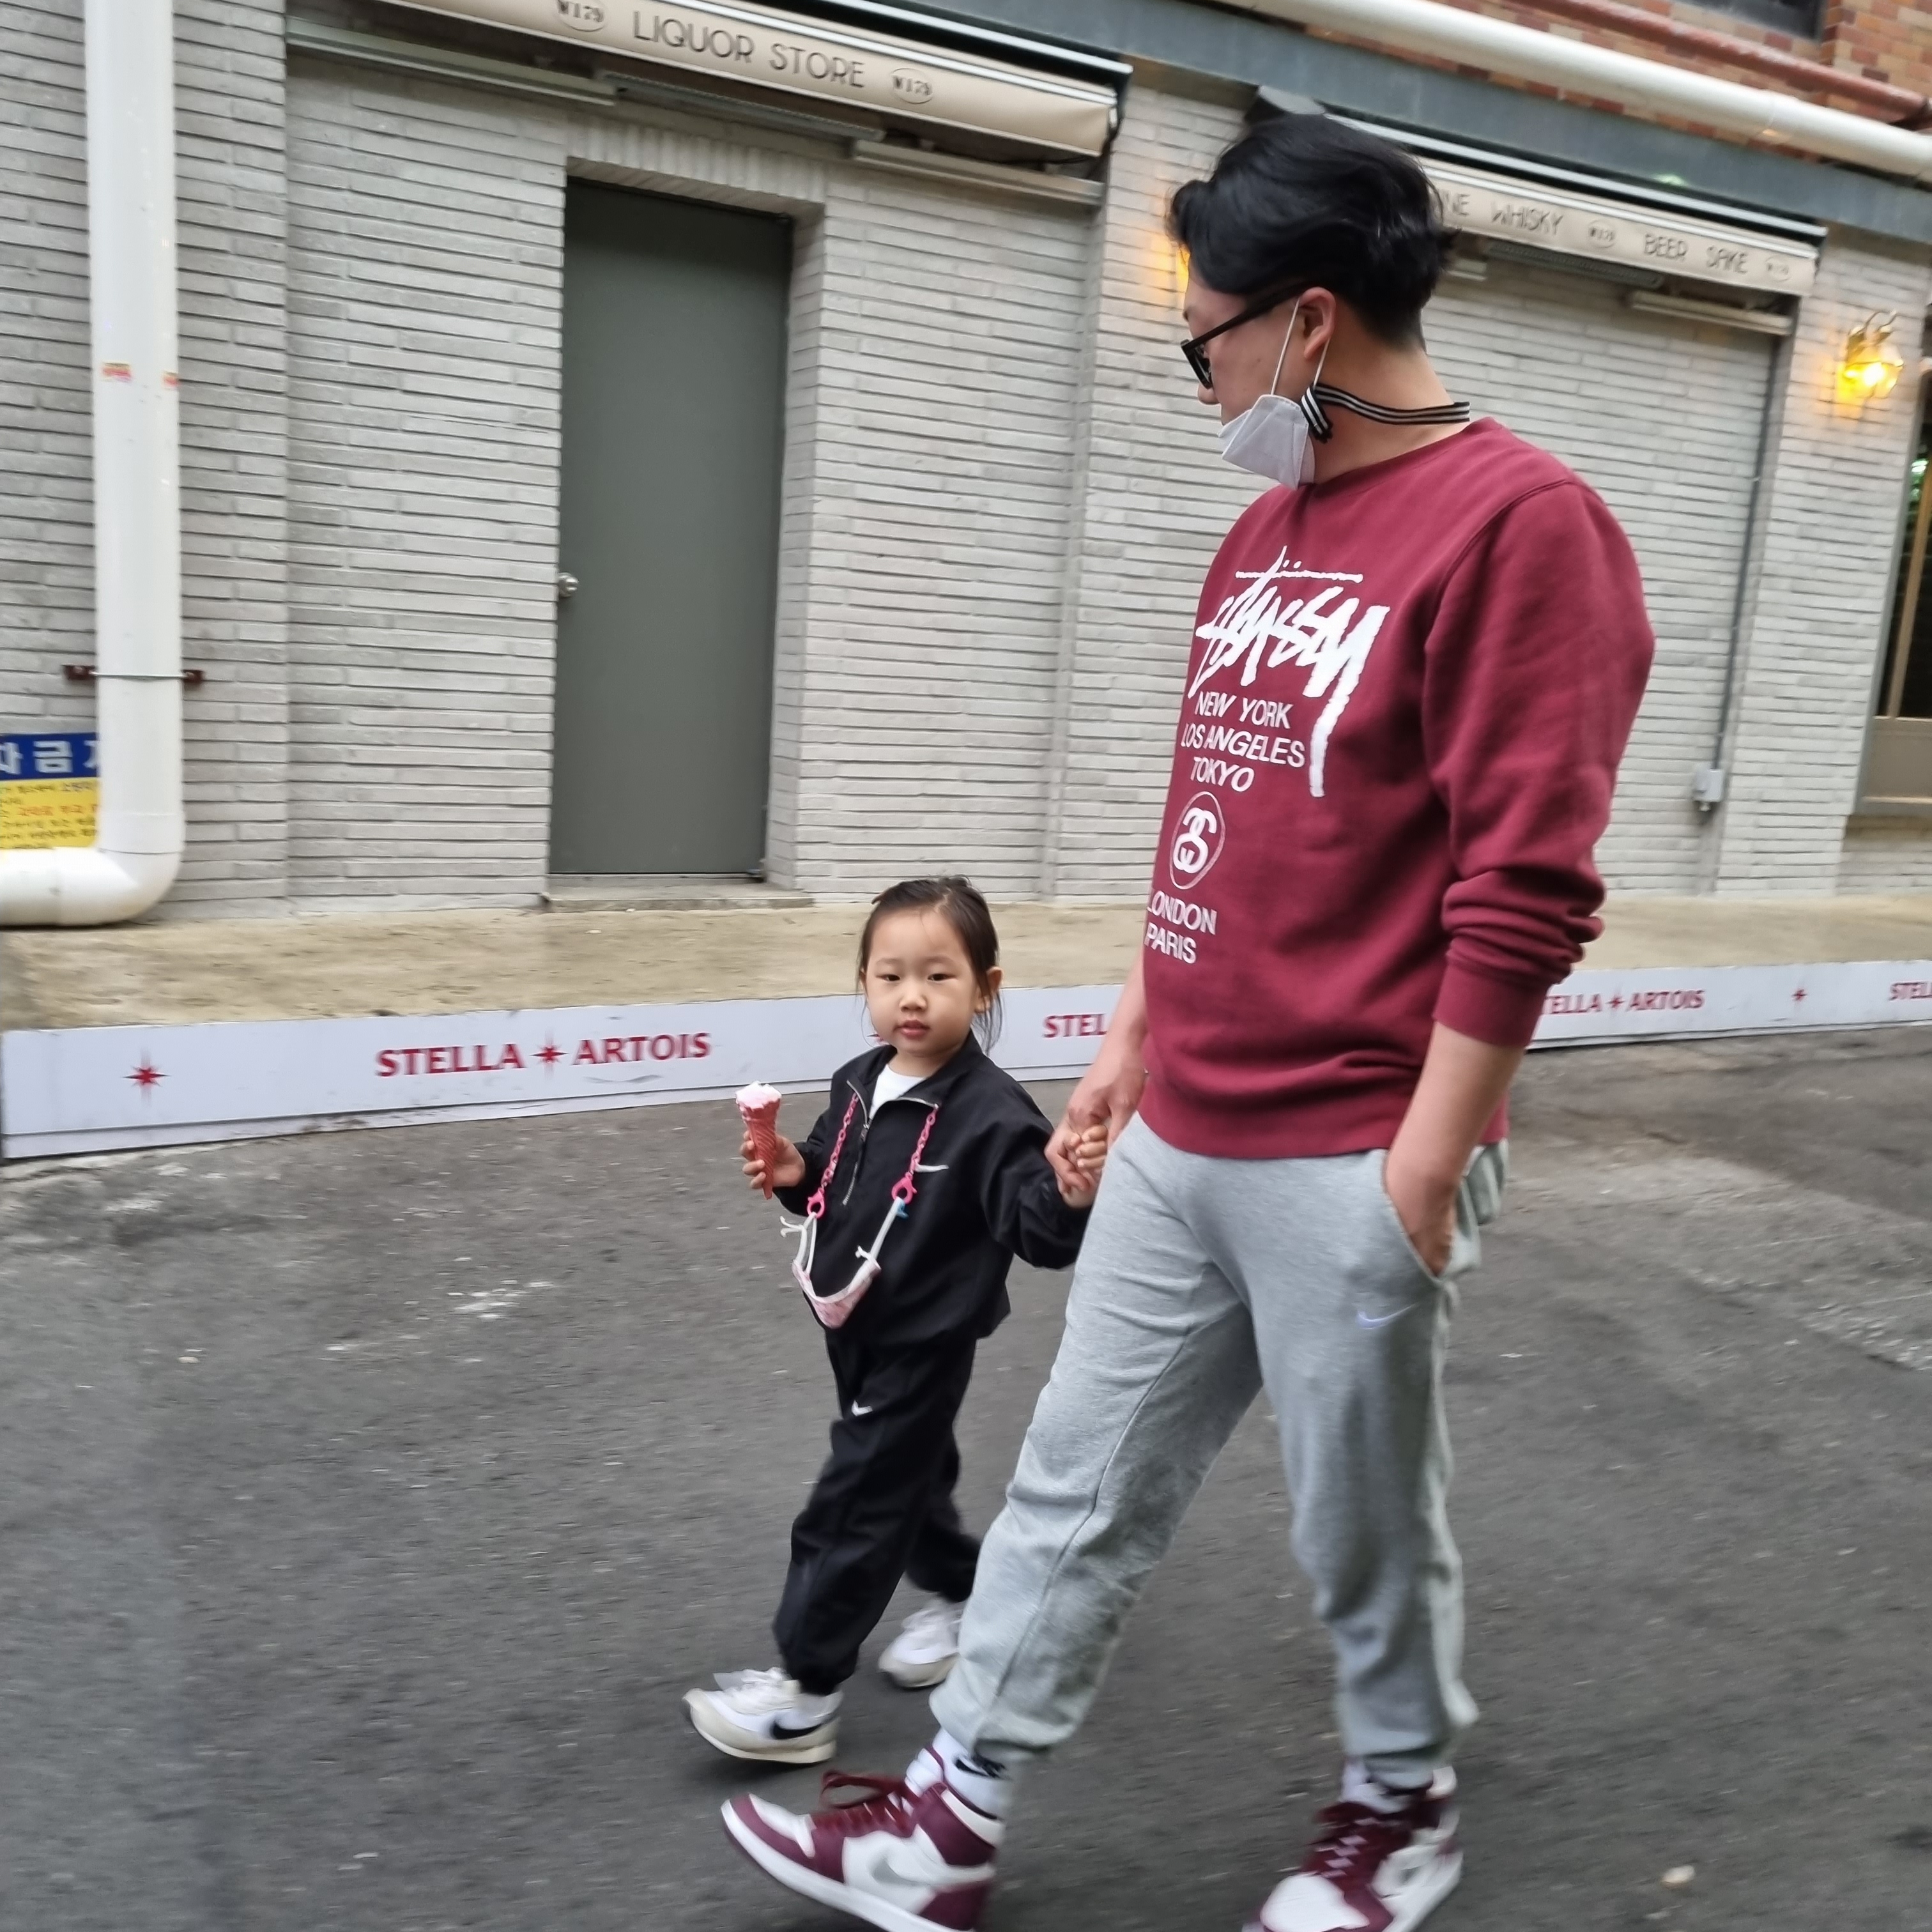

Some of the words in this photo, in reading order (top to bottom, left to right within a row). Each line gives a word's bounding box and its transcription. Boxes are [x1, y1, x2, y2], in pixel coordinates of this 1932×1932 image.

[634, 11, 755, 63] LIQUOR
[769, 43, 864, 88] STORE
[1491, 201, 1564, 235] WHISKY
[1644, 233, 1689, 263] BEER
[1706, 245, 1749, 274] SAKE
[1195, 691, 1237, 717] NEW
[1239, 697, 1294, 729] YORK
[1181, 723, 1206, 749] LOS
[1202, 724, 1306, 768] ANGELES
[1190, 756, 1255, 792] TOKYO
[1144, 922, 1197, 964] PARIS
[1627, 989, 1705, 1011] ARTOIS
[1889, 981, 1932, 1001] STEL
[1043, 1013, 1108, 1038] STEL
[375, 1043, 526, 1077] STELLA
[572, 1032, 710, 1066] ARTOIS
